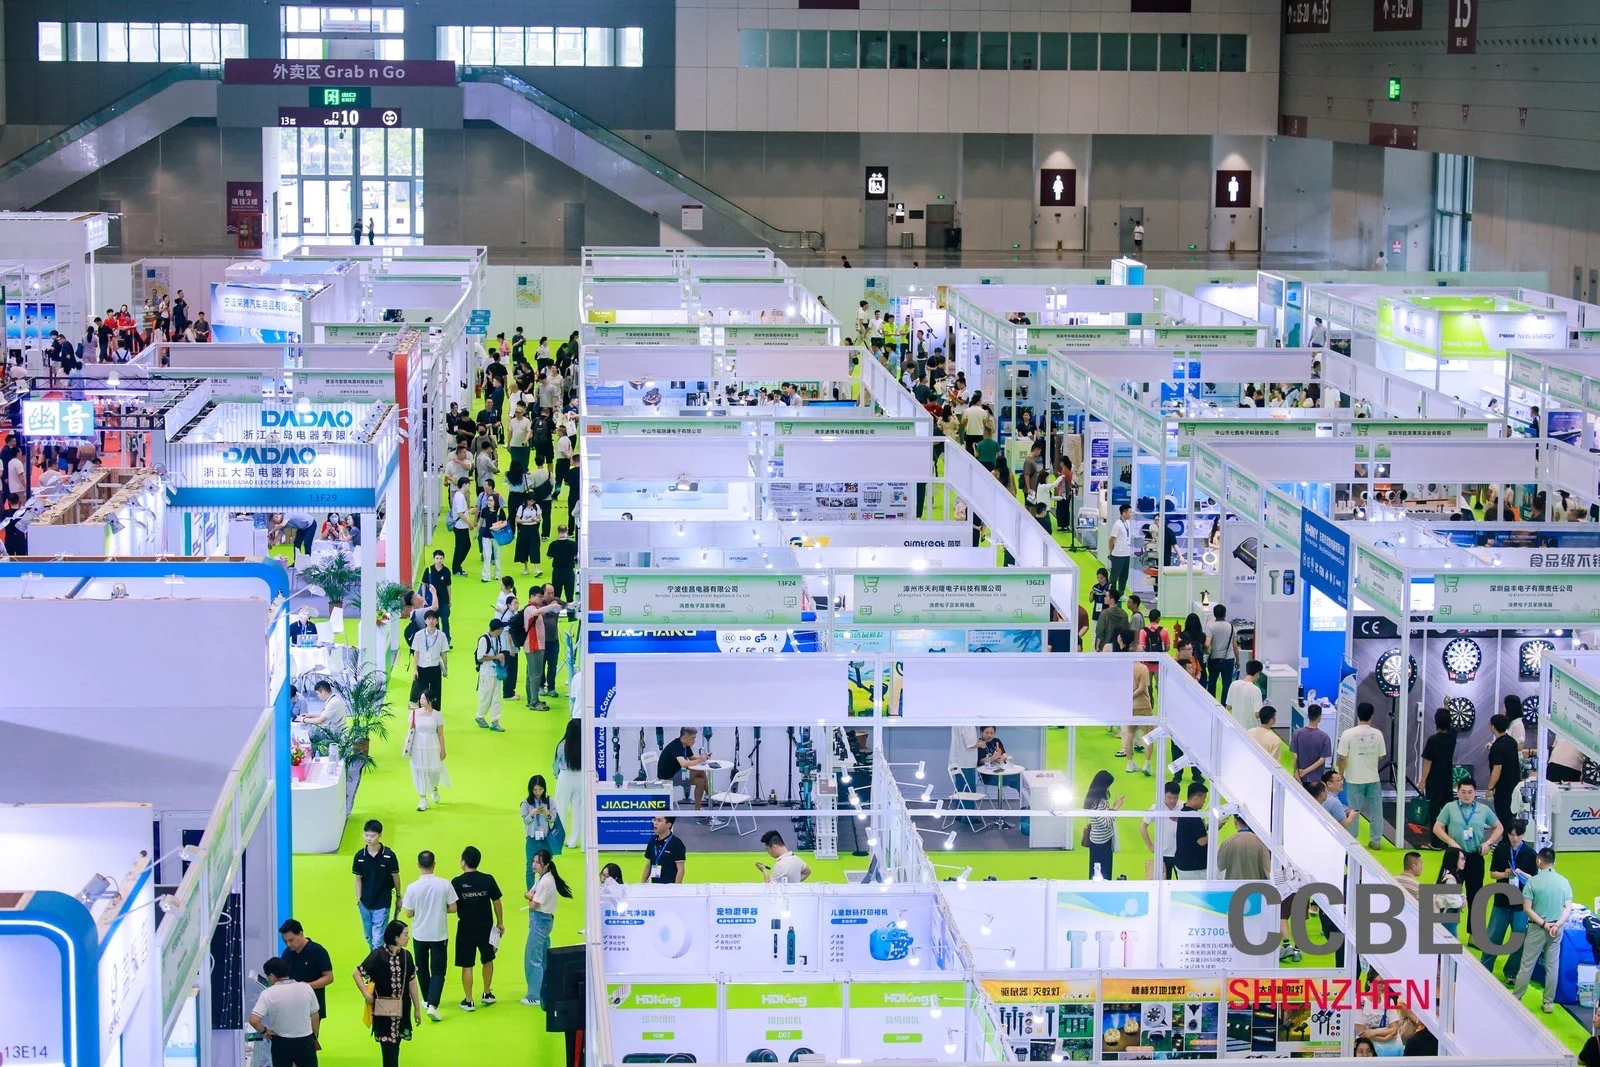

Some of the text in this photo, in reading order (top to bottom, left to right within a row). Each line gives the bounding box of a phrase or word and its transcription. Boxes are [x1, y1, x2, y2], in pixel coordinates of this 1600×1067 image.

[273, 64, 406, 79] 外卖区 Grab n Go
[341, 110, 359, 126] 10
[28, 403, 90, 434] 幽音
[261, 410, 353, 428] DADAO
[243, 430, 354, 440] 浙江大岛电器有限
[223, 447, 316, 464] DADAO
[203, 467, 336, 478] 浙江大岛电器有限公司
[667, 585, 739, 593] 宁波佳昌电器有限公司
[1361, 621, 1380, 634] CE
[754, 633, 767, 643] GS
[1570, 806, 1600, 818] FunV
[1001, 987, 1060, 996] 驱鼠器 灭蚊灯
[1131, 986, 1185, 995] 棒棒灯地埋灯
[635, 994, 681, 1007] HDKing
[761, 994, 807, 1007] HDKing
[884, 992, 930, 1006] HDKing
[4, 1046, 48, 1058] 13E14
